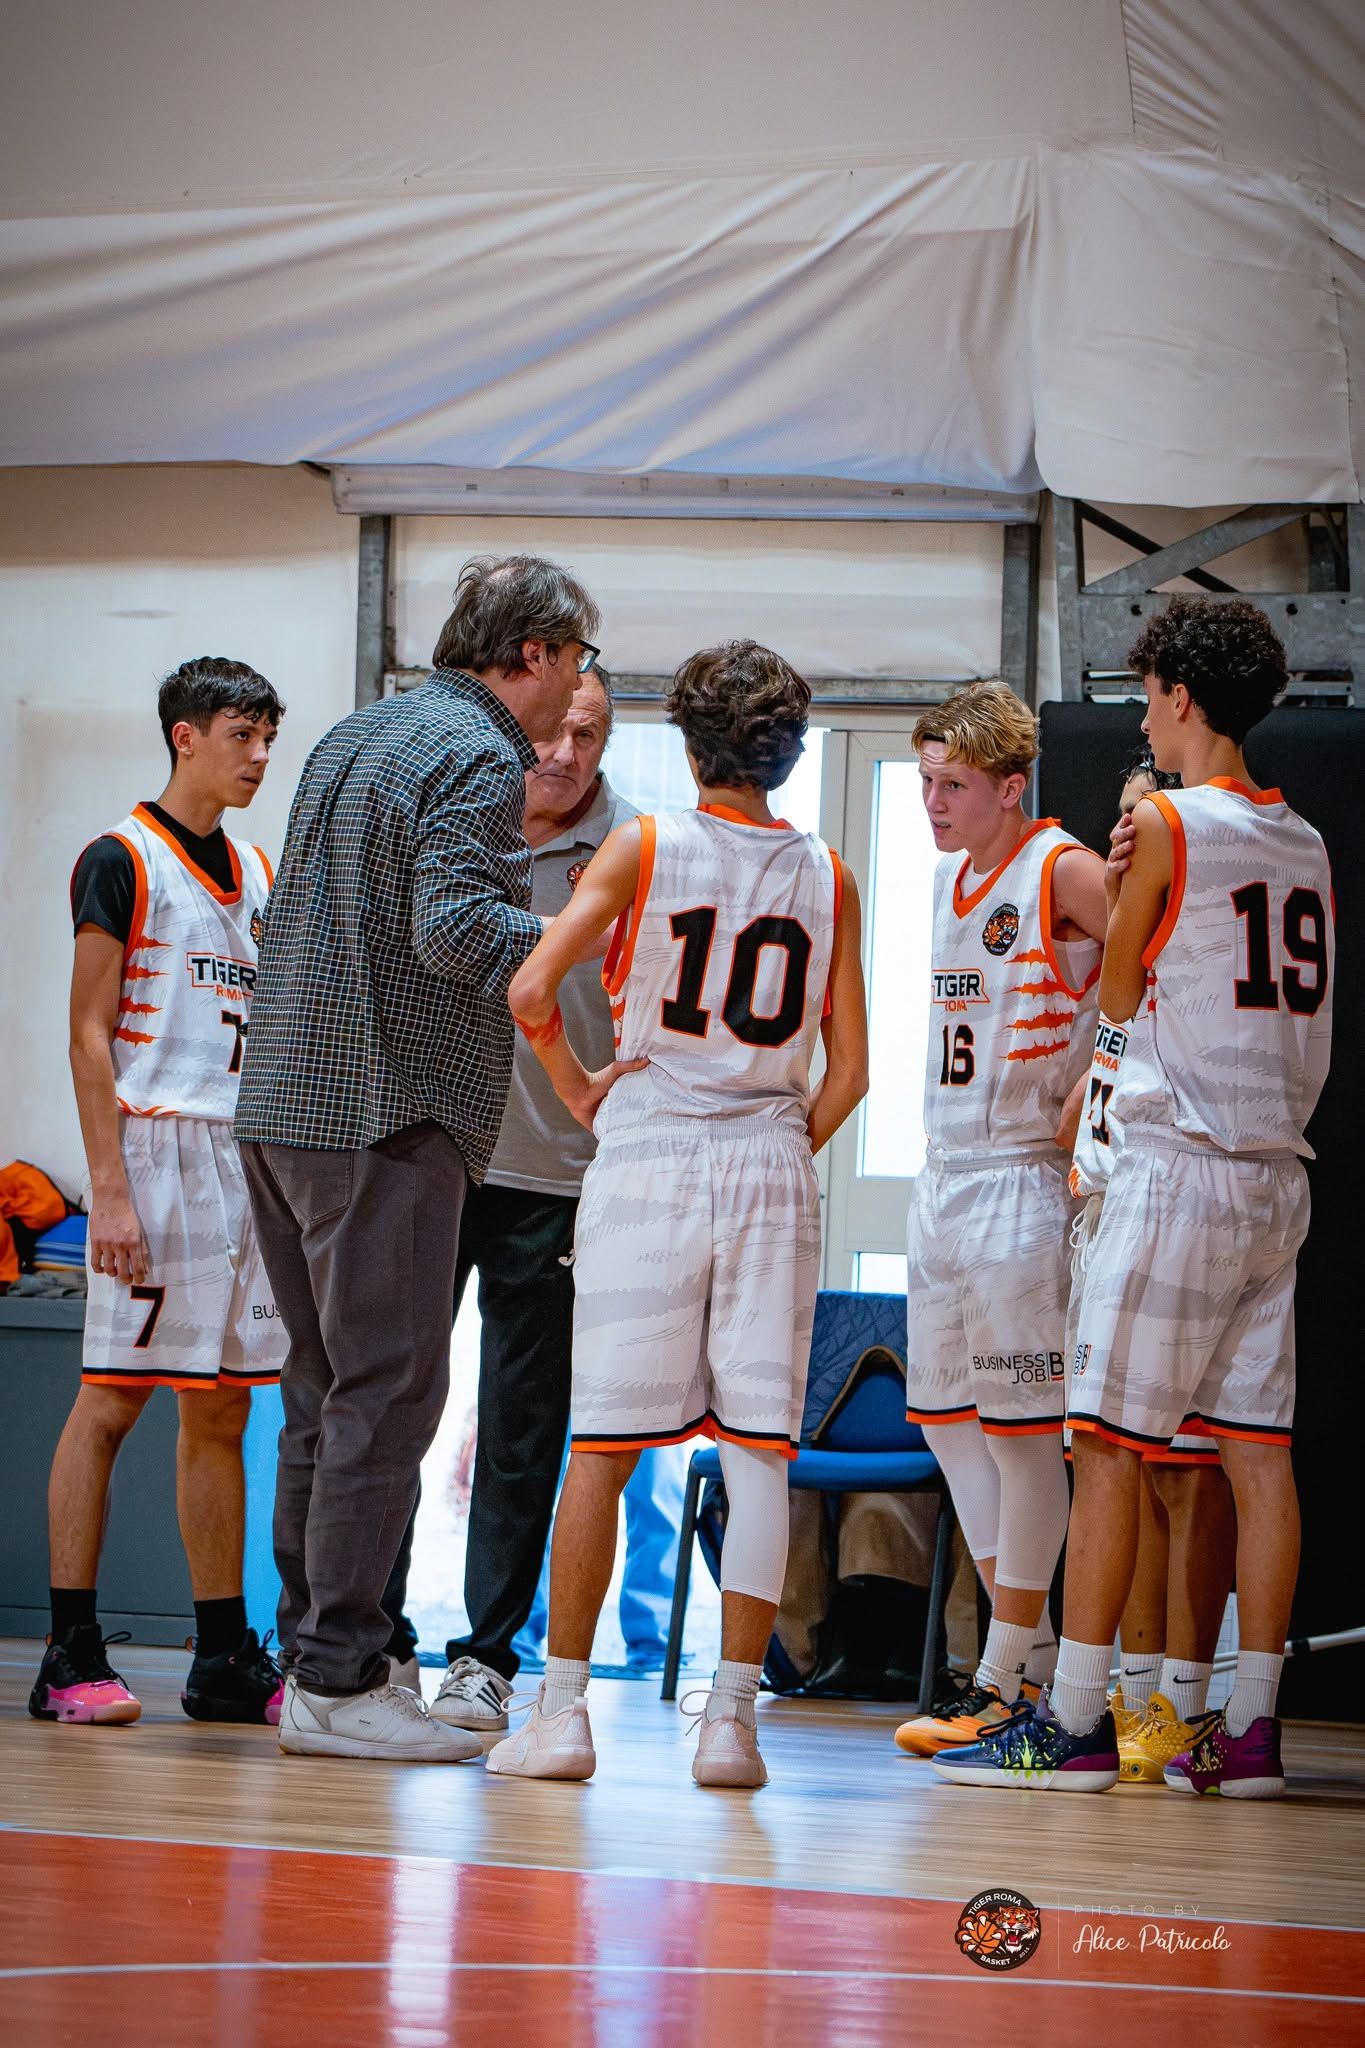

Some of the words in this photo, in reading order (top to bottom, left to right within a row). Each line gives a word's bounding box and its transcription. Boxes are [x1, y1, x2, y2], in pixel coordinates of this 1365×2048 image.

[191, 958, 257, 990] TIGER
[661, 905, 813, 1048] 10
[1230, 880, 1328, 1017] 19
[221, 1010, 243, 1073] 7
[940, 1024, 975, 1086] 16
[130, 1285, 166, 1348] 7
[972, 1353, 1046, 1371] BUSINESS
[1012, 1368, 1046, 1385] JOB
